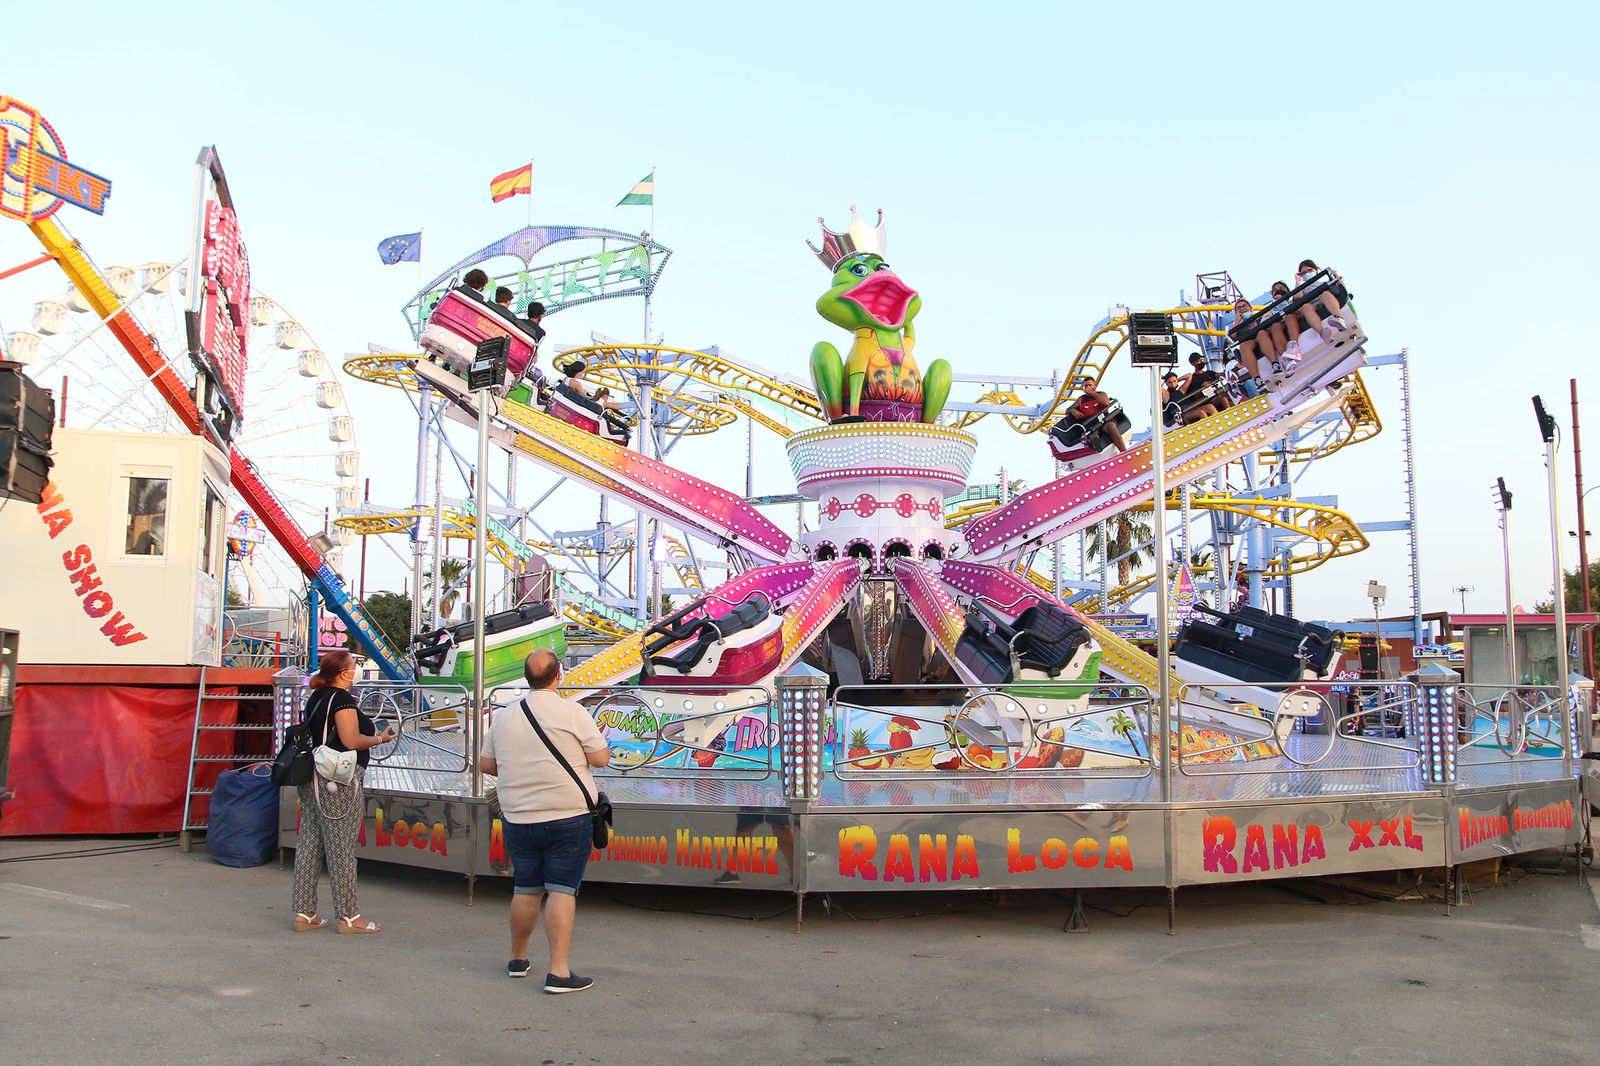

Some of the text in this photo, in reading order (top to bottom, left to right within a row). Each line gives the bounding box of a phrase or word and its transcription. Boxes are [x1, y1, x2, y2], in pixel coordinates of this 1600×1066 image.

[8, 145, 107, 211] JEKT
[37, 479, 148, 647] NA SHOW
[375, 807, 448, 857] LOCA
[607, 830, 669, 865] FERNANDO
[676, 828, 780, 876] MARTINEZ
[838, 825, 1135, 883] RANA LOCA
[1202, 815, 1424, 874] RANA XXL
[1457, 799, 1574, 853] MAXIMA SEGURIDAD
